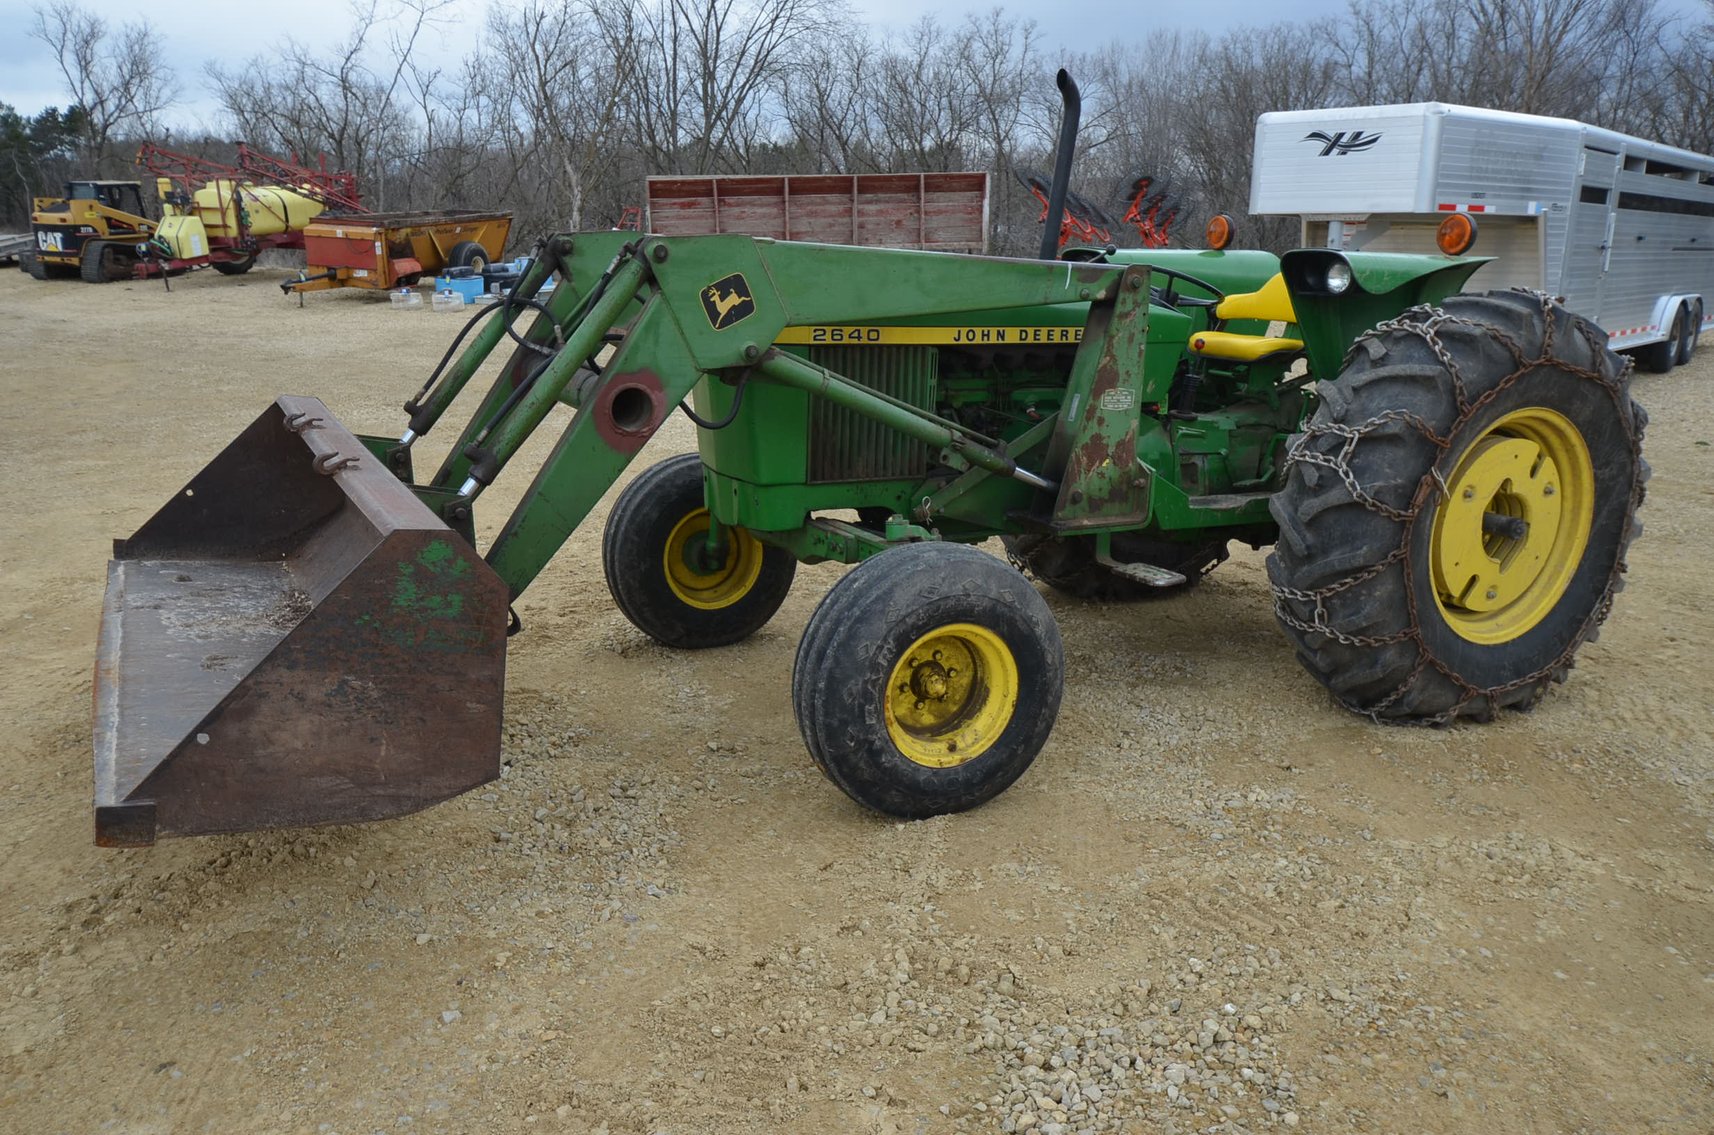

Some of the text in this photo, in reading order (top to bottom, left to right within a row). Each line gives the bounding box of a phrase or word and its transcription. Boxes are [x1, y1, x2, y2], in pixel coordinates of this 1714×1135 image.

[37, 231, 63, 252] CAT
[812, 328, 881, 342] 2640
[953, 329, 1082, 342] JOHN DEERE
